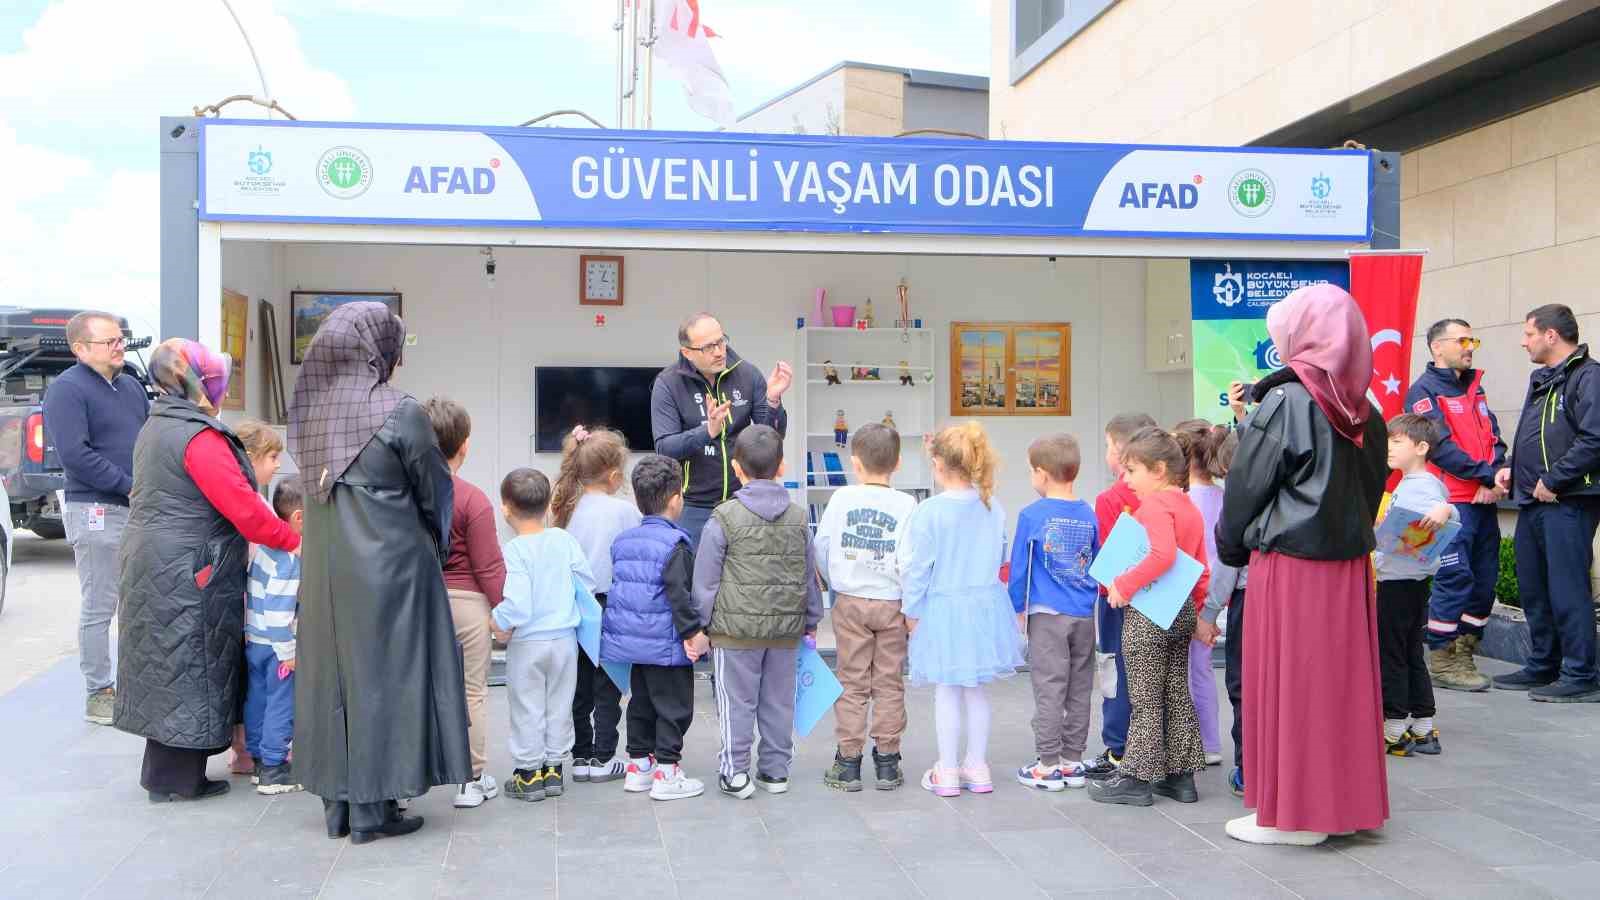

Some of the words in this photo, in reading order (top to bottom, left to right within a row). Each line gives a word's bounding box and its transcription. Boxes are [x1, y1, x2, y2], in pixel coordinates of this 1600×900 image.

[404, 165, 496, 195] AFAD
[571, 146, 759, 202] GÜVENLİ
[773, 160, 918, 214] YAŞAM
[933, 163, 1054, 208] ODASI
[1119, 182, 1199, 210] AFAD
[846, 508, 898, 533] AMPLIFY
[856, 525, 883, 539] YOUR
[841, 532, 896, 555] STRENGTHS
